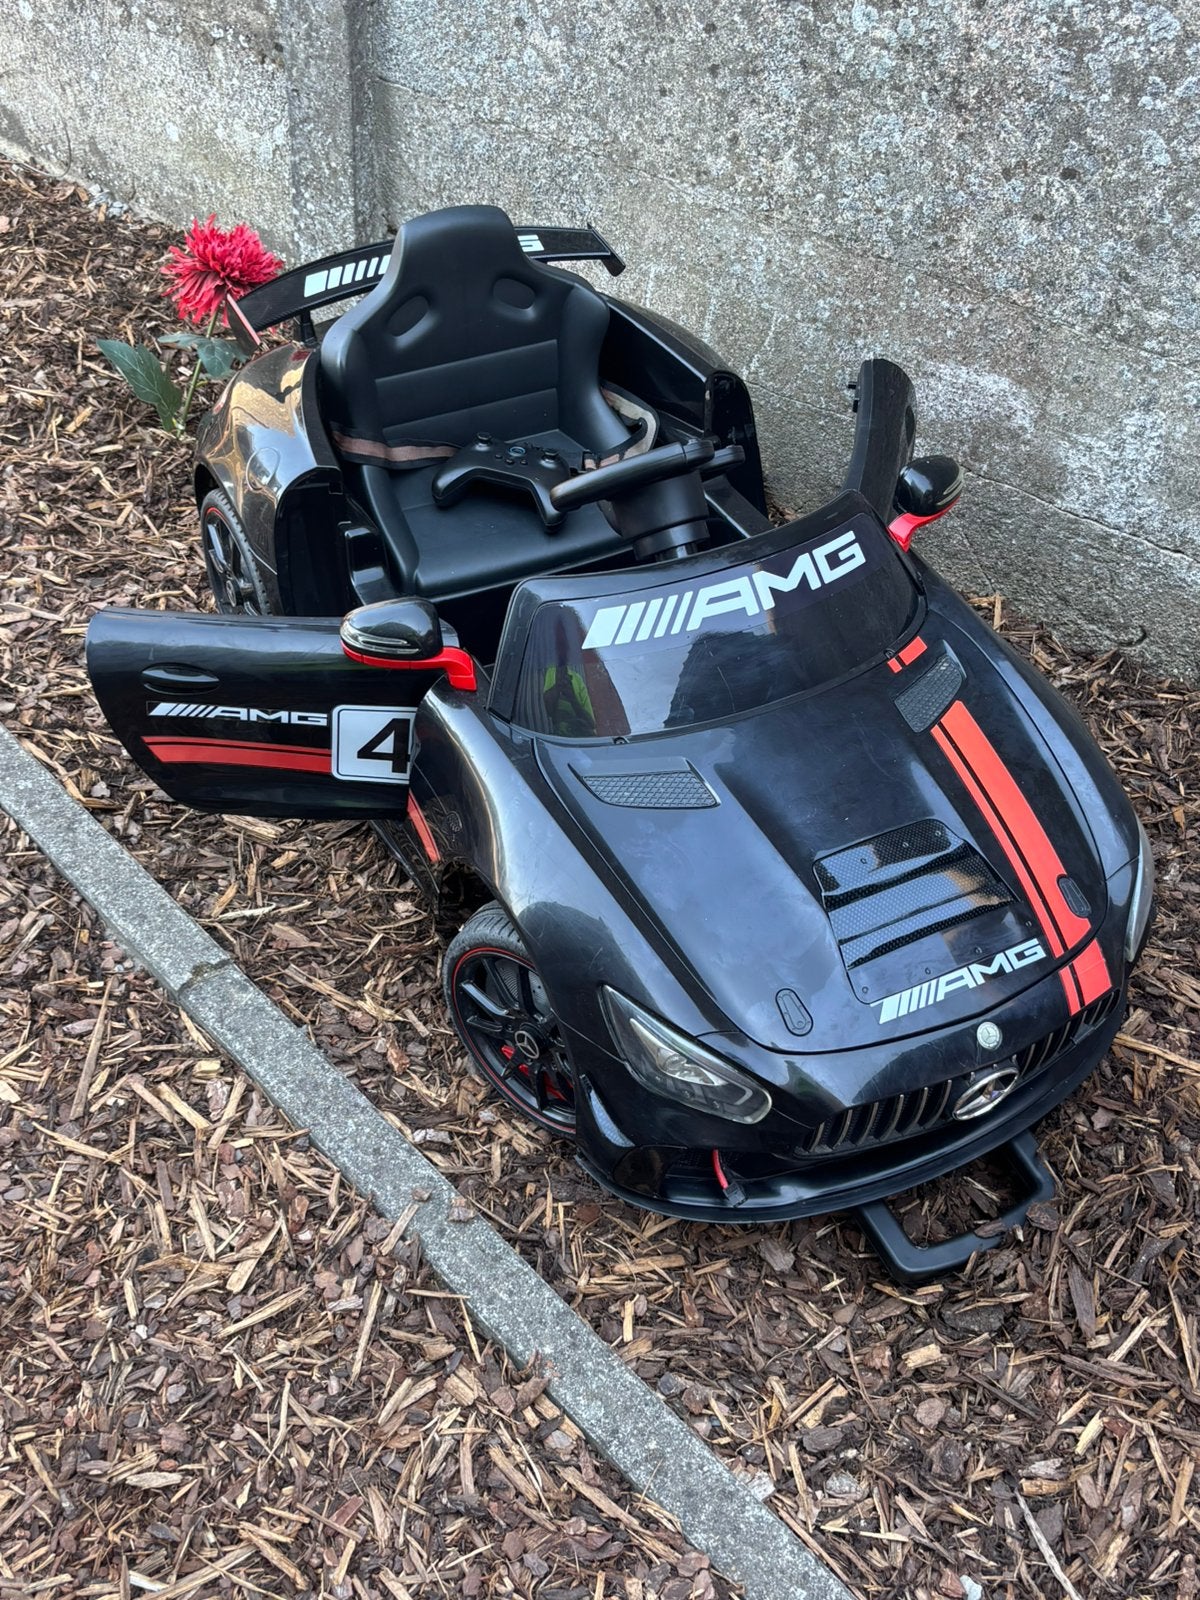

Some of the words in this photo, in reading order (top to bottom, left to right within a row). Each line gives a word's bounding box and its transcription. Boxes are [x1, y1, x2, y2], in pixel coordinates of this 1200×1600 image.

[686, 530, 866, 632] AMG
[206, 705, 328, 727] AMG
[357, 717, 411, 774] 4
[935, 937, 1047, 1002] AMG
